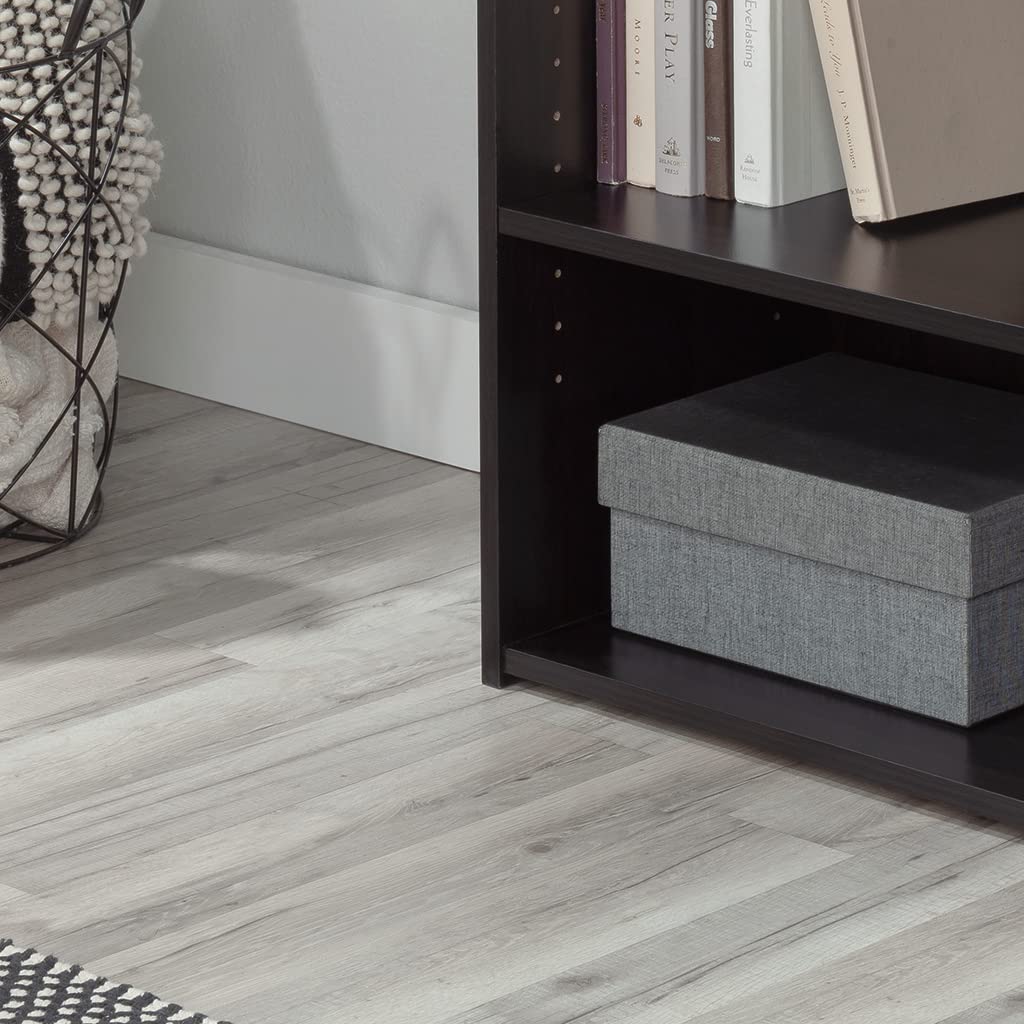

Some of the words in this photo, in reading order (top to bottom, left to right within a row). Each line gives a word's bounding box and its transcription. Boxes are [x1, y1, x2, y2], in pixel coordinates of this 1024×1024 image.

[598, 2, 608, 23] year
[705, 0, 718, 49] Glass
[820, 0, 836, 30] Leads
[633, 18, 641, 75] MOORE
[664, 33, 679, 84] PLAY
[828, 34, 835, 46] to
[829, 51, 842, 78] You
[843, 115, 857, 169] Monninger
